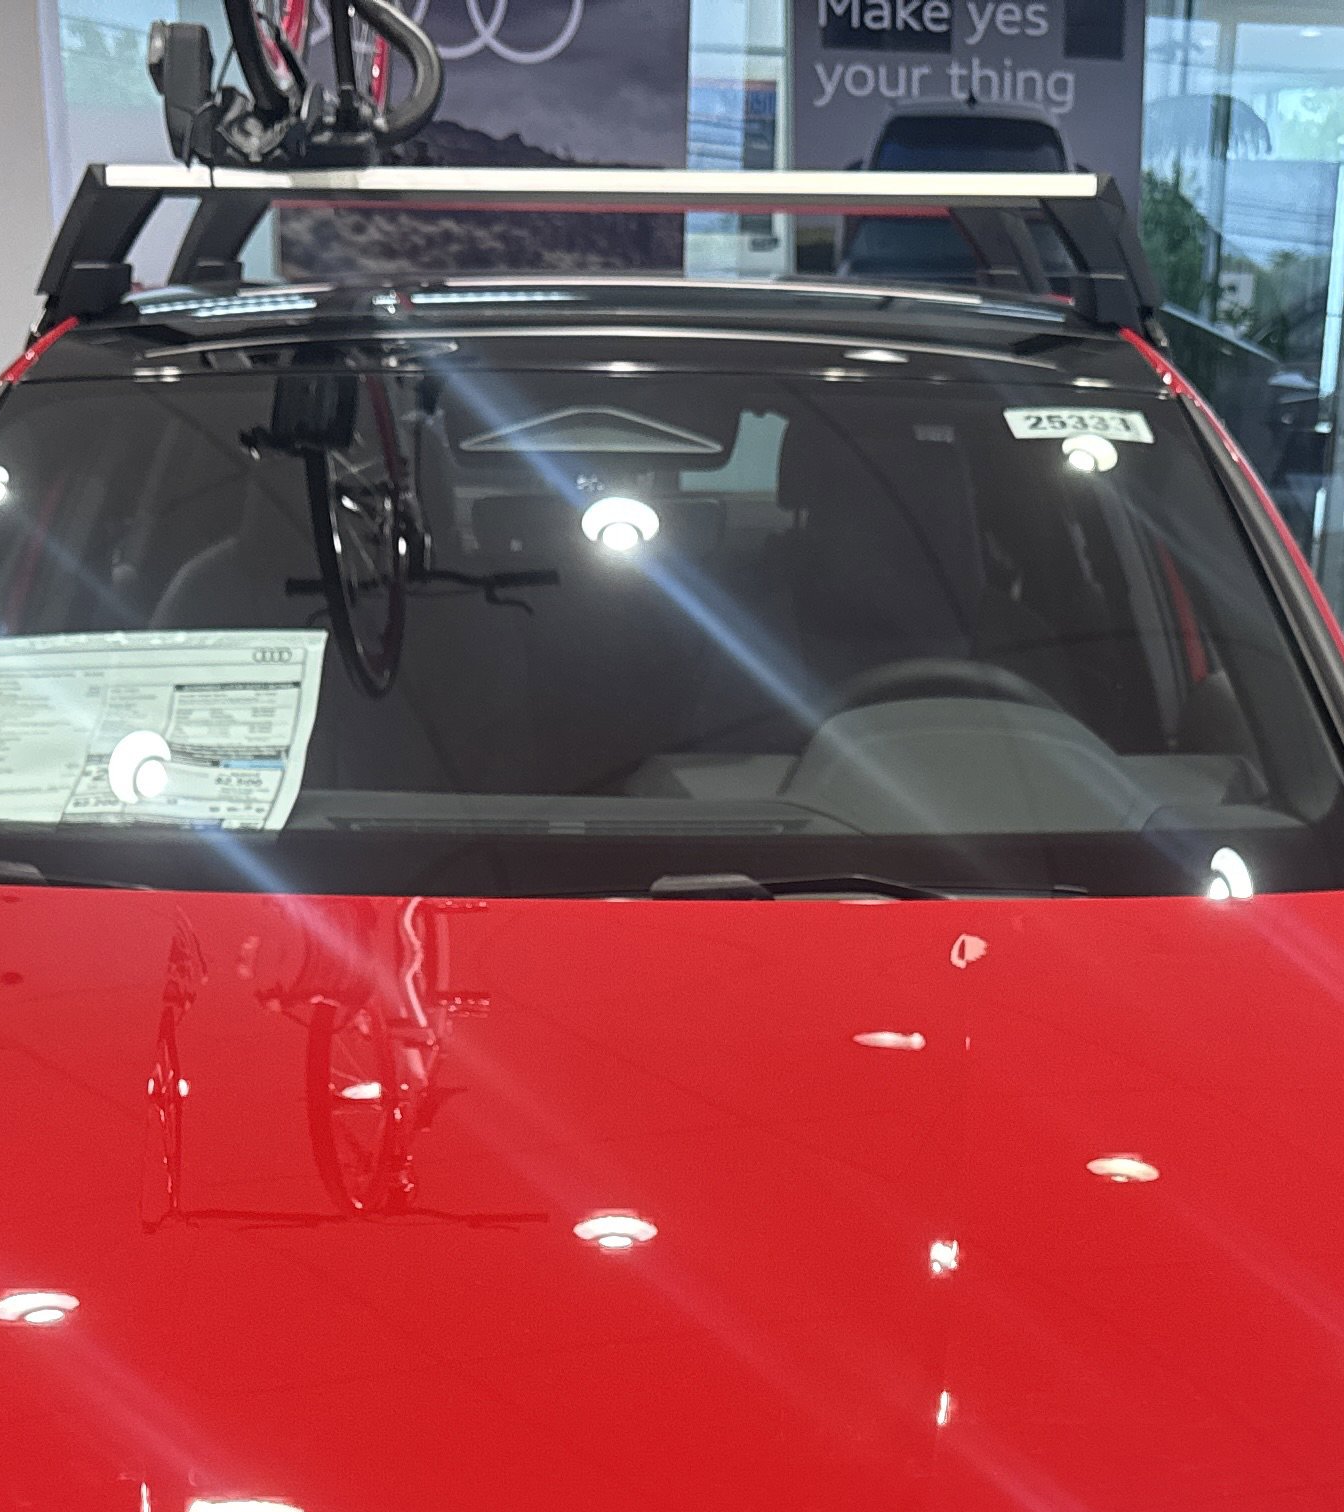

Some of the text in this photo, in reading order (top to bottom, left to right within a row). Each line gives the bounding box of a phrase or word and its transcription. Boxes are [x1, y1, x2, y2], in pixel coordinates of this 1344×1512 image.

[817, 0, 1049, 44] Make yes
[813, 57, 1076, 114] your thing
